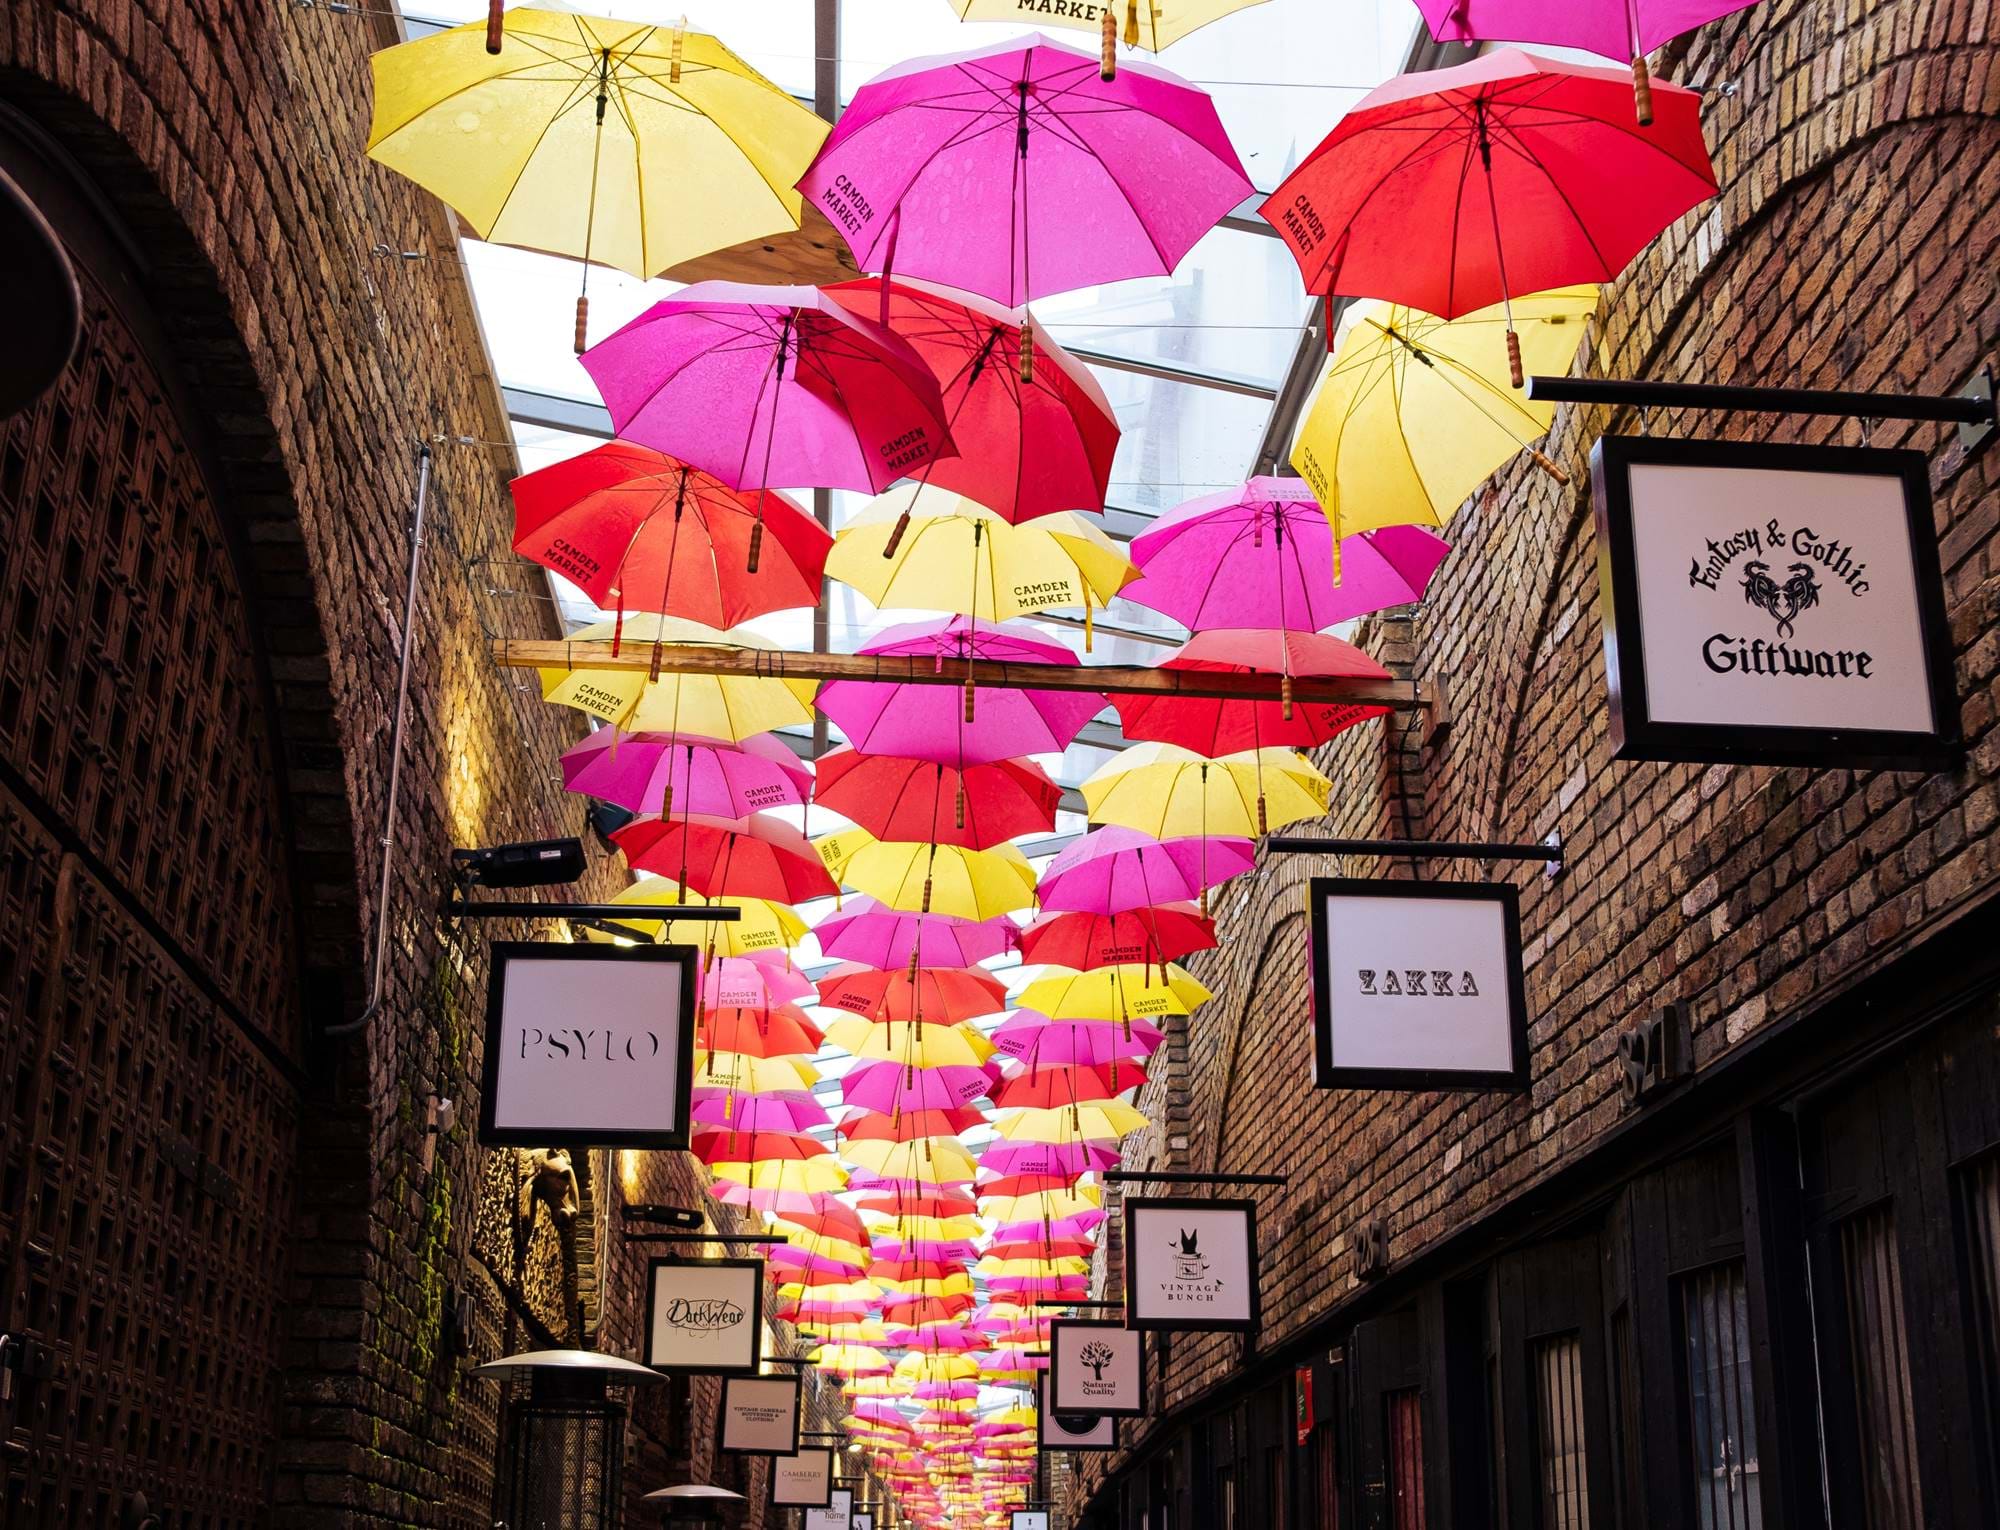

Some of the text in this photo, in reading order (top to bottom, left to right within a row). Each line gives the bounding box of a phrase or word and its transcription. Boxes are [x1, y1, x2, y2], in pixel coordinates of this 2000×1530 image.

[835, 174, 874, 223] CAMDEN
[822, 188, 862, 236] MARKET
[1295, 194, 1327, 244] CAMDEN
[1281, 208, 1314, 256] MARKET
[880, 427, 926, 457] CAMDEN
[887, 442, 930, 472] MARKET
[1304, 447, 1328, 491] CAMDEN
[1303, 459, 1327, 505] MARKET
[544, 548, 592, 583] MARKET
[553, 538, 600, 573] CAMDEN
[1689, 518, 1870, 597] Fantasy & Gothic
[1014, 580, 1069, 596] CAMDEN
[1018, 592, 1072, 608] MARKET
[1702, 633, 1873, 679] Giftware
[572, 693, 616, 715] MARKET
[579, 684, 624, 706] CAMDEN
[1328, 706, 1366, 730] MARKET
[745, 785, 782, 798] CAMDEN
[749, 794, 786, 807] MARKET
[741, 931, 776, 941] CAMDEN
[745, 938, 778, 948] MARKET
[1102, 946, 1141, 955] CAMDEN
[1103, 954, 1141, 963] MARKET
[1358, 969, 1479, 996] ZAKKA
[838, 1000, 867, 1012] MARKET
[841, 993, 871, 1006] CAMDEN
[1133, 998, 1167, 1008] CAMDEN
[1136, 1005, 1168, 1014] MARKET
[521, 1028, 659, 1061] PSYLO
[1161, 1284, 1220, 1292] VINTAGE
[1082, 1387, 1116, 1396] Quality
